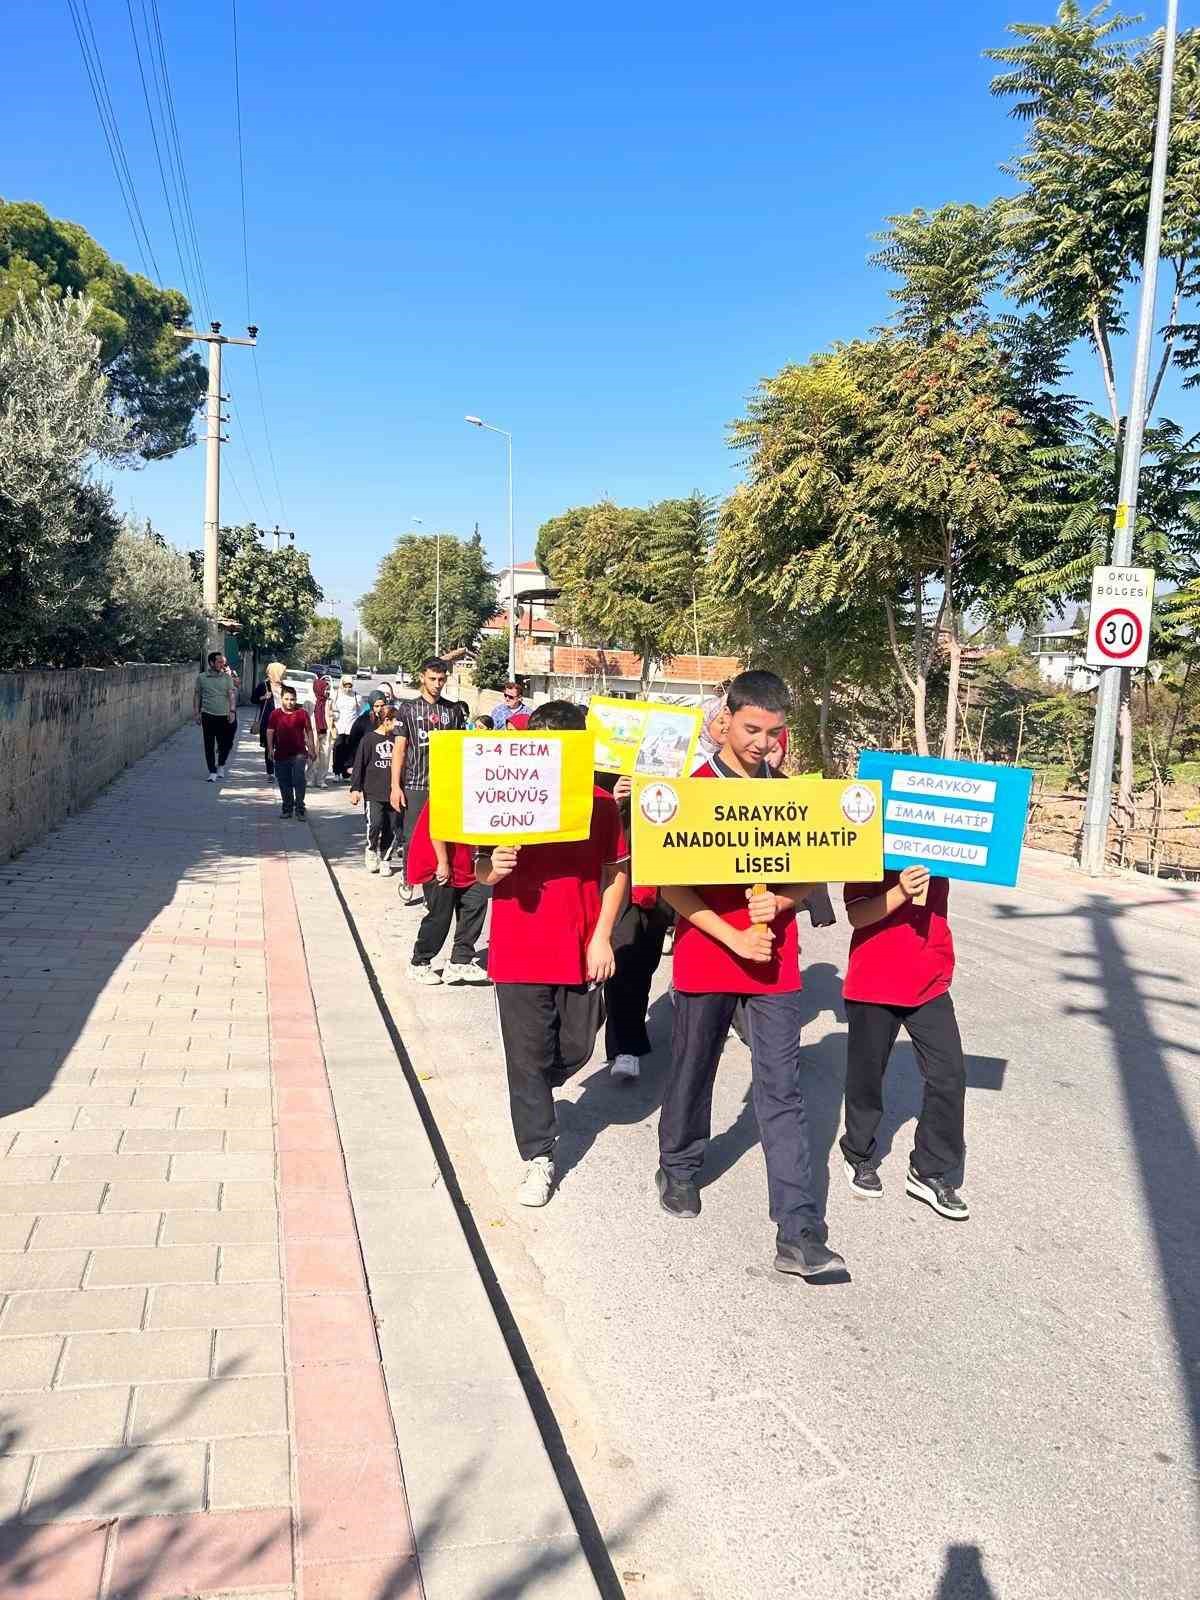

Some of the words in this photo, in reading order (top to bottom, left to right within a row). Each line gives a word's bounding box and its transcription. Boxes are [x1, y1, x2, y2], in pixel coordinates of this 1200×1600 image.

[1108, 572, 1140, 582] OKUL
[1104, 621, 1134, 646] 30
[474, 743, 503, 757] 3-4
[510, 741, 550, 757] EKİM
[485, 765, 540, 781] DÜNYA
[475, 787, 549, 805] YÜRÜYÜŞ
[489, 811, 535, 828] GÜNÜ
[714, 801, 809, 822] SARAYKÖY
[943, 811, 989, 828] HATİP
[662, 831, 749, 848] ANADOLU
[754, 826, 801, 848] İMAM
[807, 826, 858, 847] HATİP
[892, 838, 979, 860] ORTAOKULU
[735, 853, 791, 874] LİSESİ
